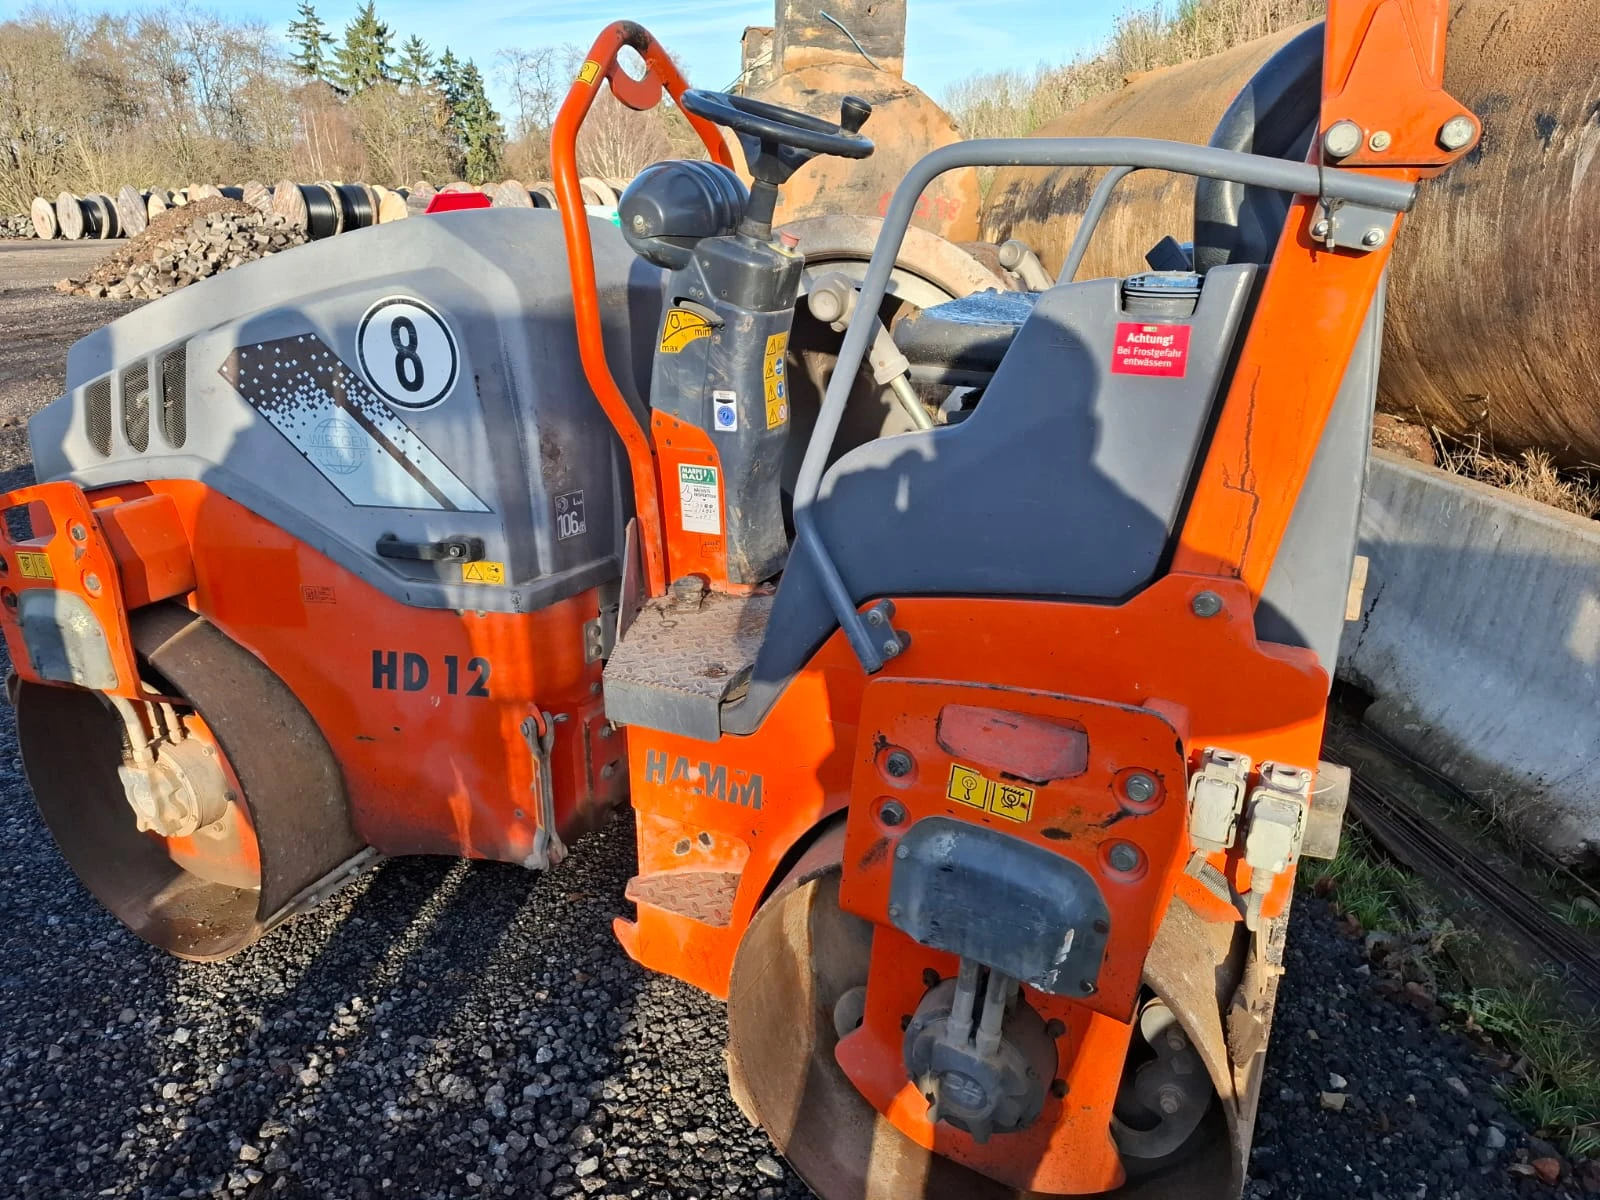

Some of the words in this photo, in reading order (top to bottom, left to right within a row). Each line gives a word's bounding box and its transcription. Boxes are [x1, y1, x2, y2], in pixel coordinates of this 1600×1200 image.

[1127, 333, 1174, 346] Achtung!
[391, 316, 425, 392] 8
[1117, 346, 1130, 355] Bei
[1133, 347, 1182, 358] Frostgefahr
[1123, 357, 1172, 368] entwässern
[309, 434, 369, 447] WIRTGEN
[314, 449, 366, 459] GROUP
[682, 473, 703, 481] BAU
[558, 511, 578, 537] 106
[372, 650, 429, 692] HD
[444, 655, 492, 698] 12
[645, 749, 764, 811] HAMM
